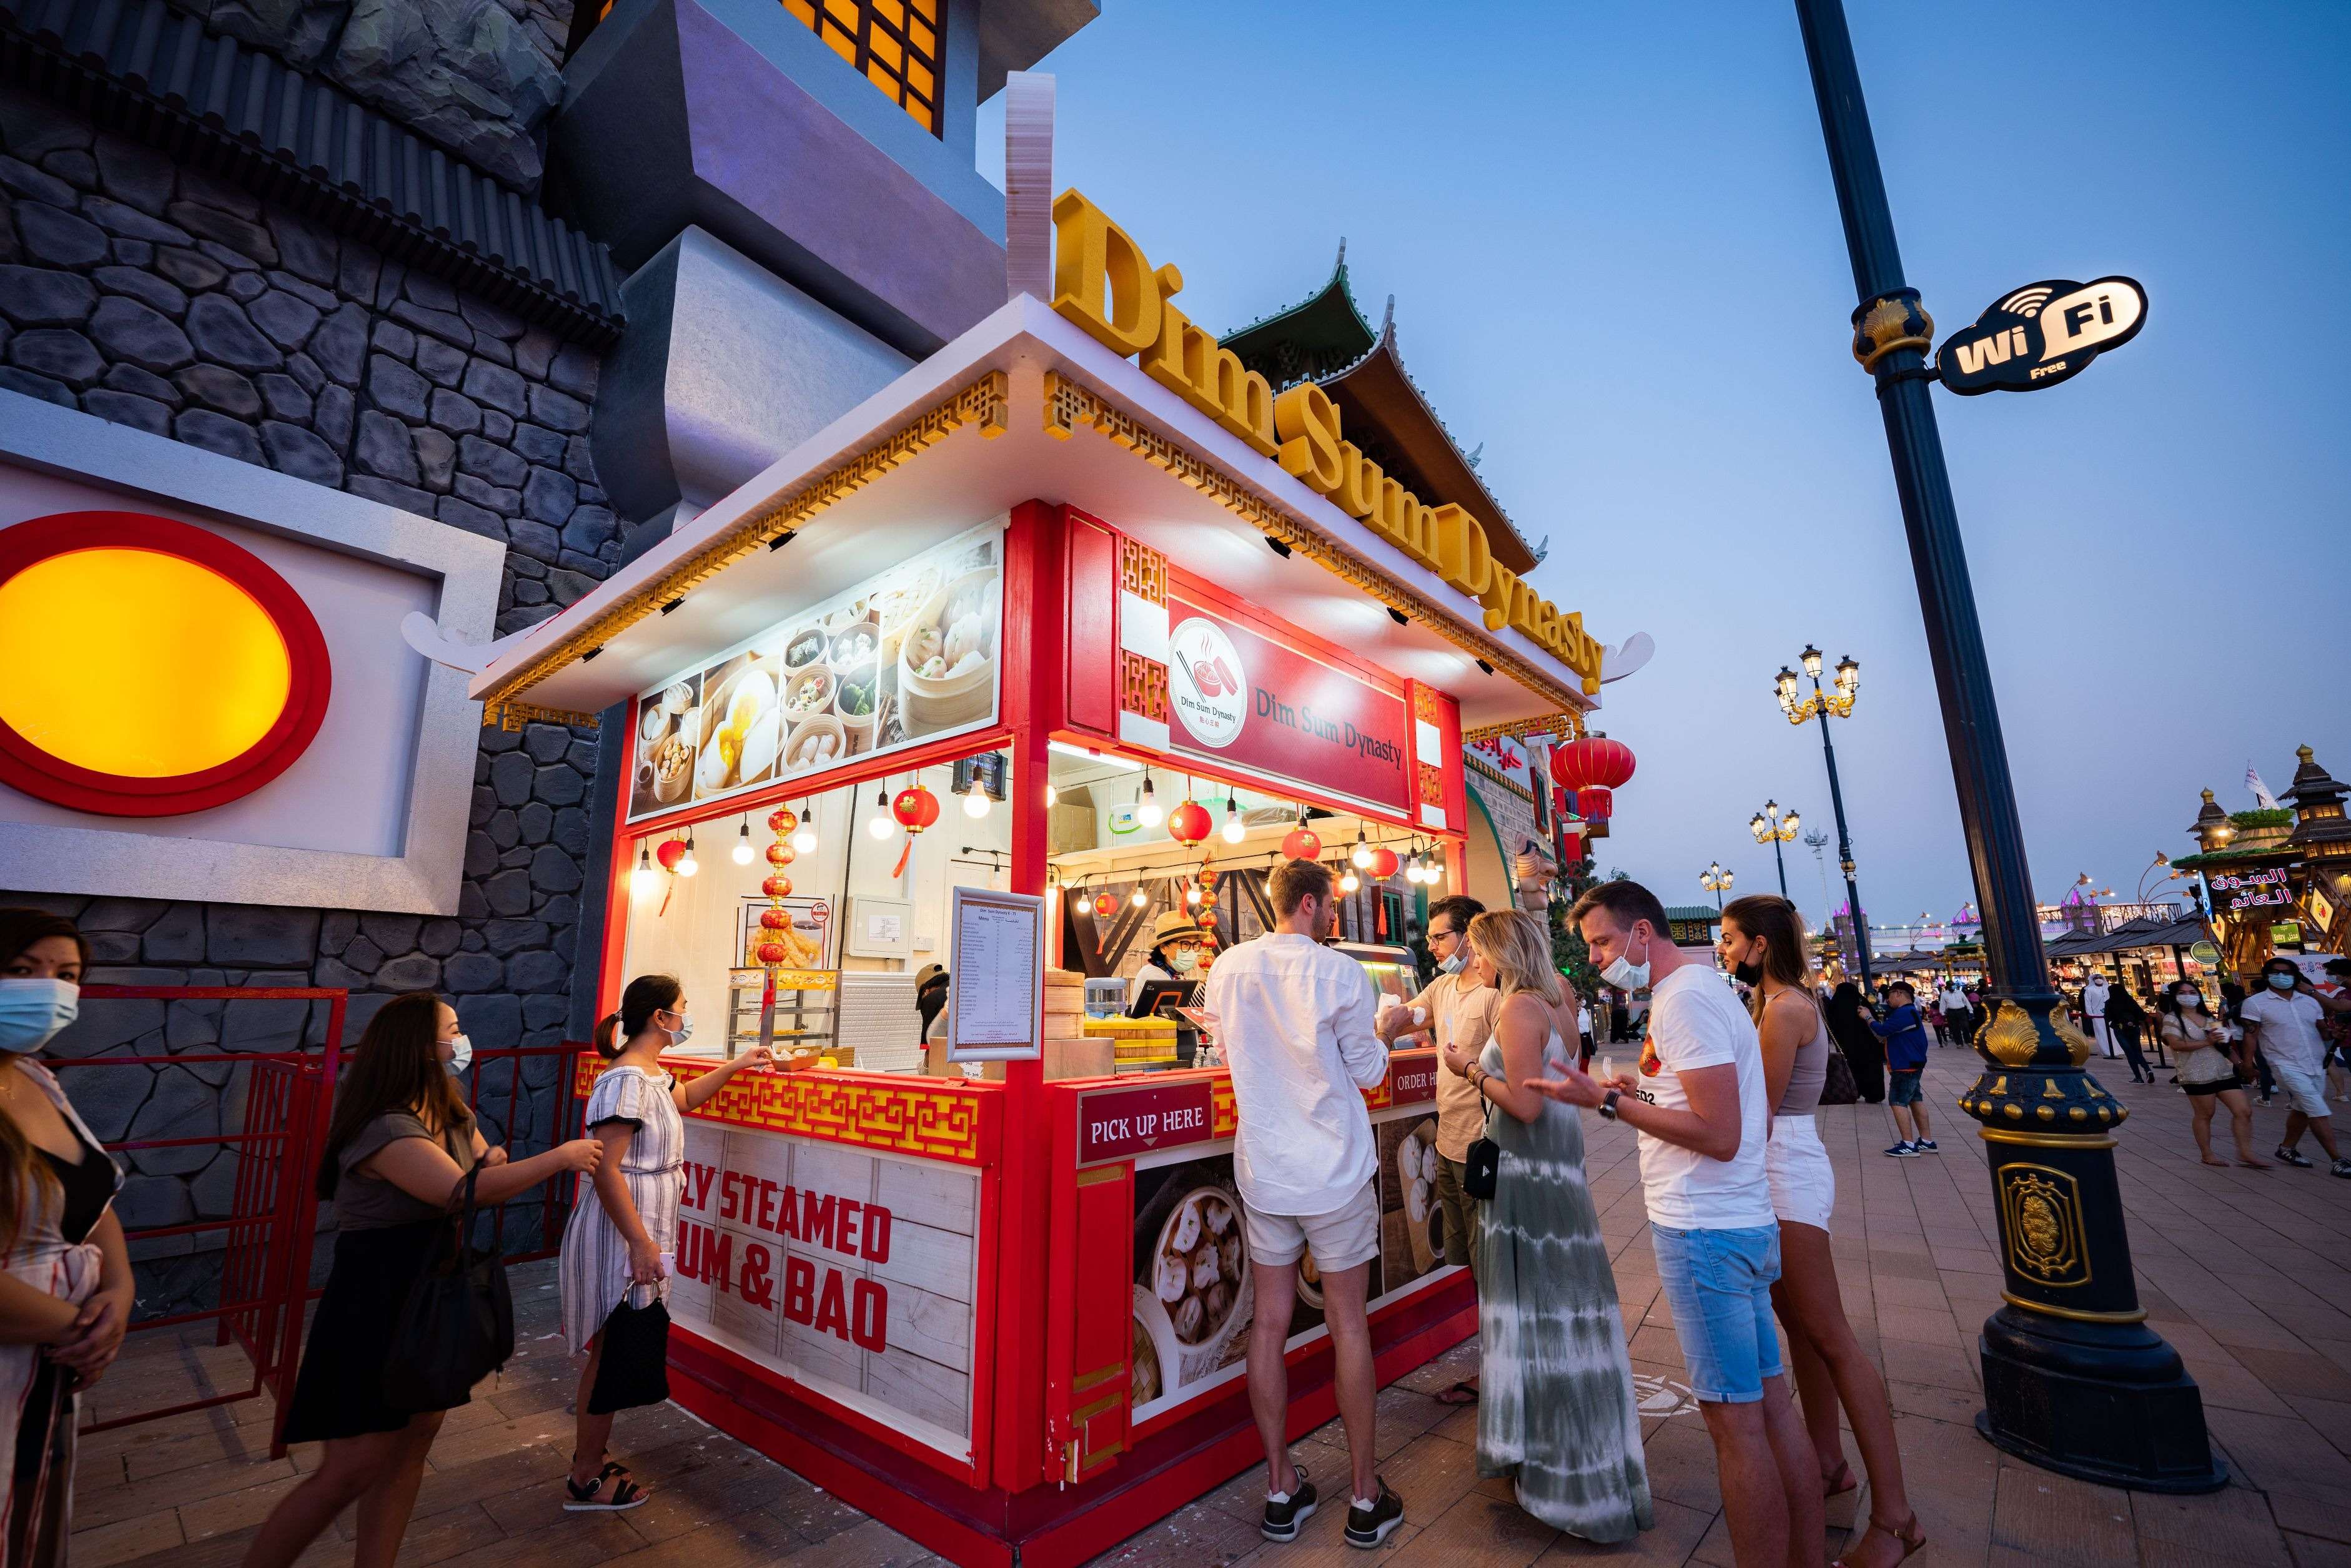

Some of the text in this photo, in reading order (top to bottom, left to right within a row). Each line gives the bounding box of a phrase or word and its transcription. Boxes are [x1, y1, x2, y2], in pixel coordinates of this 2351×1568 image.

[1955, 295, 2114, 374] Wi Fi
[2031, 361, 2067, 380] Free
[1051, 187, 1604, 696] Dim Sum Dynasty
[1181, 696, 1236, 723] Dim Sum Dynasty
[1255, 688, 1401, 770] Dim Sum Dynasty
[2211, 869, 2287, 890] السوق
[2230, 889, 2292, 909] العائم
[2274, 934, 2285, 942] Entry
[2287, 932, 2299, 941] مدخل
[1398, 1073, 1426, 1090] ORDER
[1091, 1107, 1203, 1144] PICK UP HERE
[720, 1170, 891, 1264] STEAMED
[740, 1243, 773, 1311] &
[784, 1255, 888, 1353] BAO
